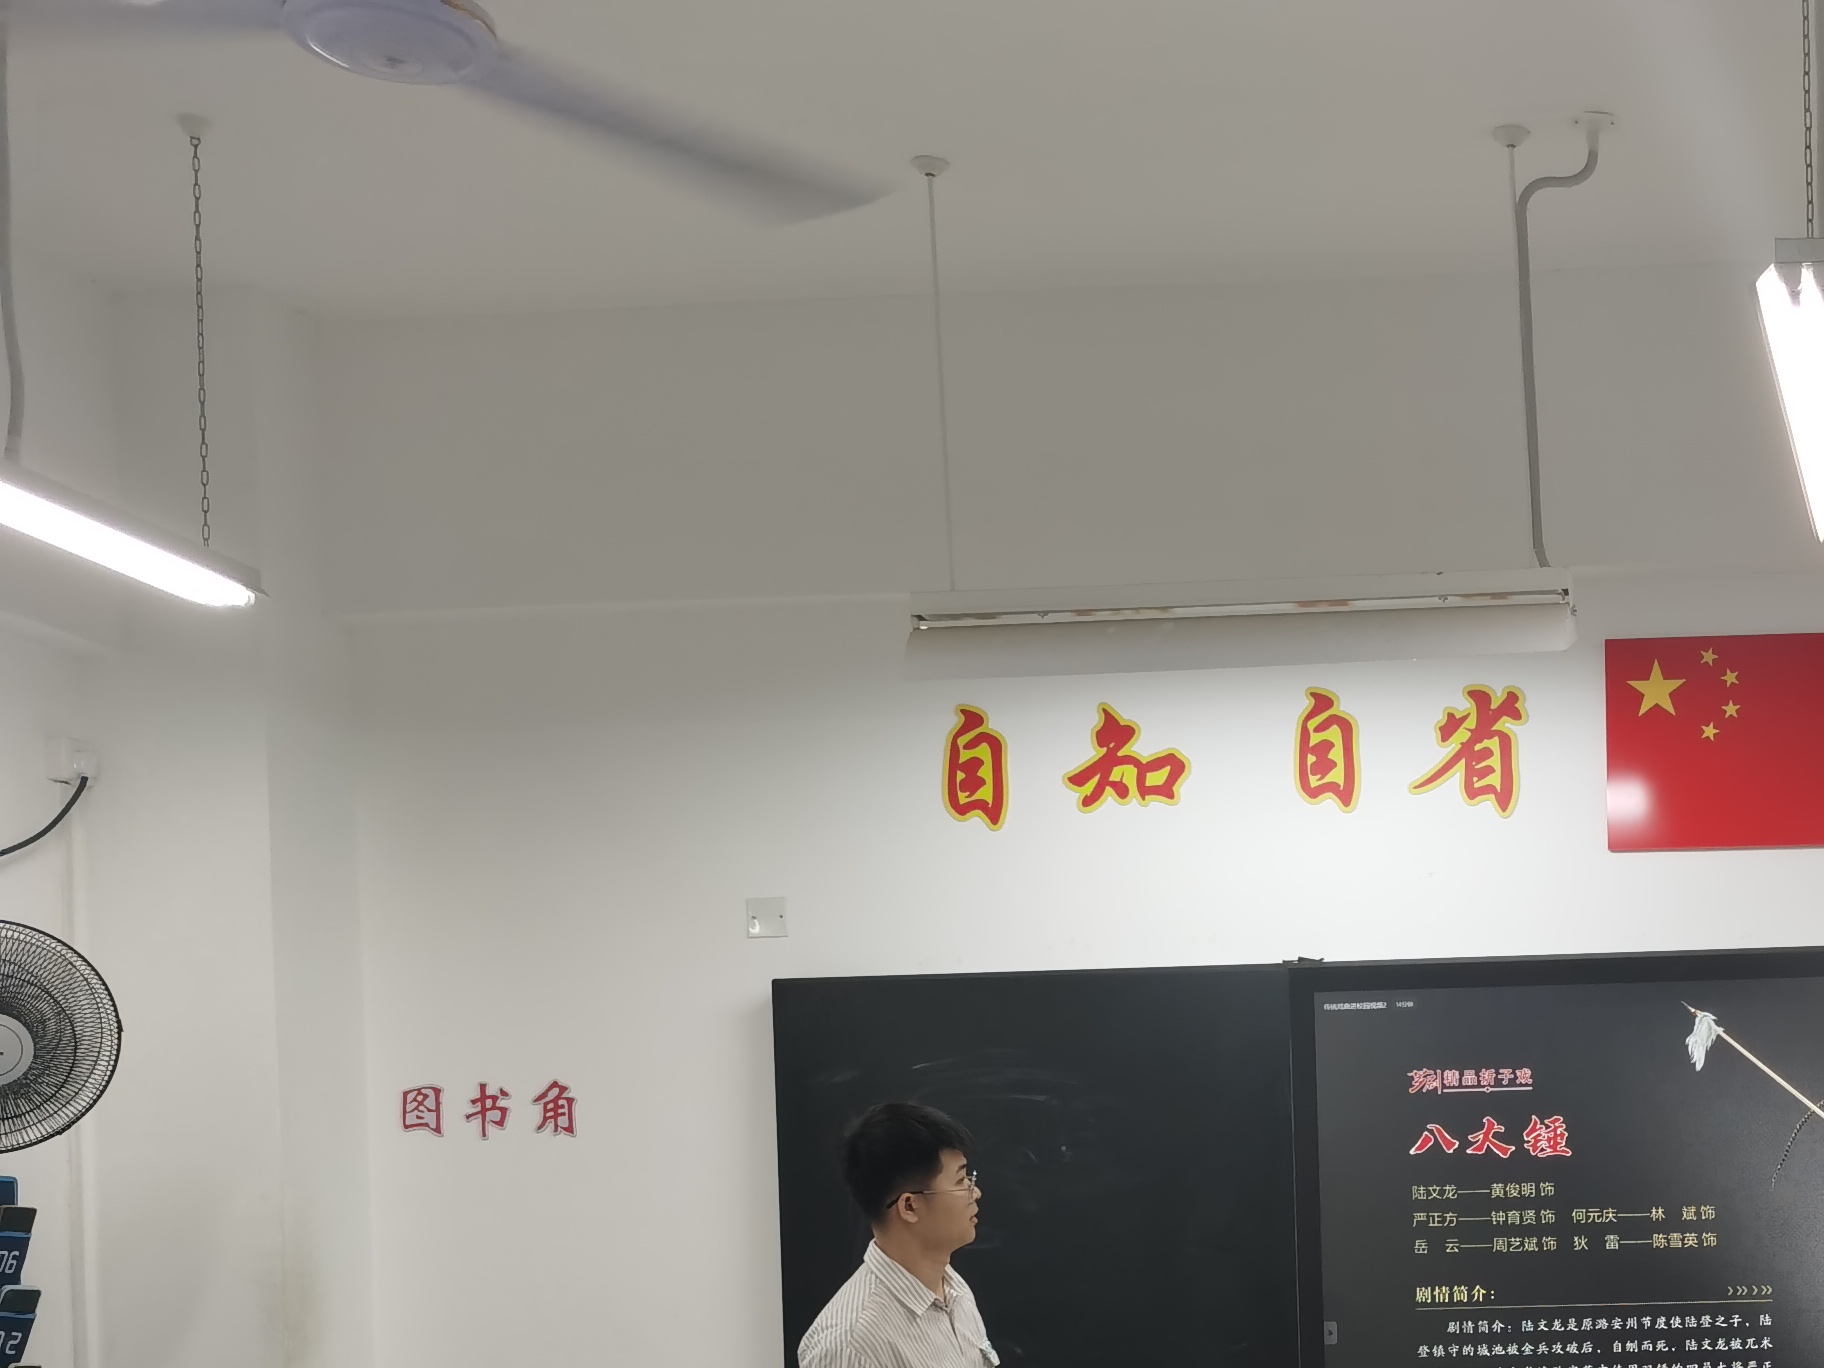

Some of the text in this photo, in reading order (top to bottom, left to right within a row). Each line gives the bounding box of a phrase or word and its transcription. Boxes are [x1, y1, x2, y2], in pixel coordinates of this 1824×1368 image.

[401, 1078, 578, 1140] 图书角
[1409, 1114, 1572, 1158] 八大锤
